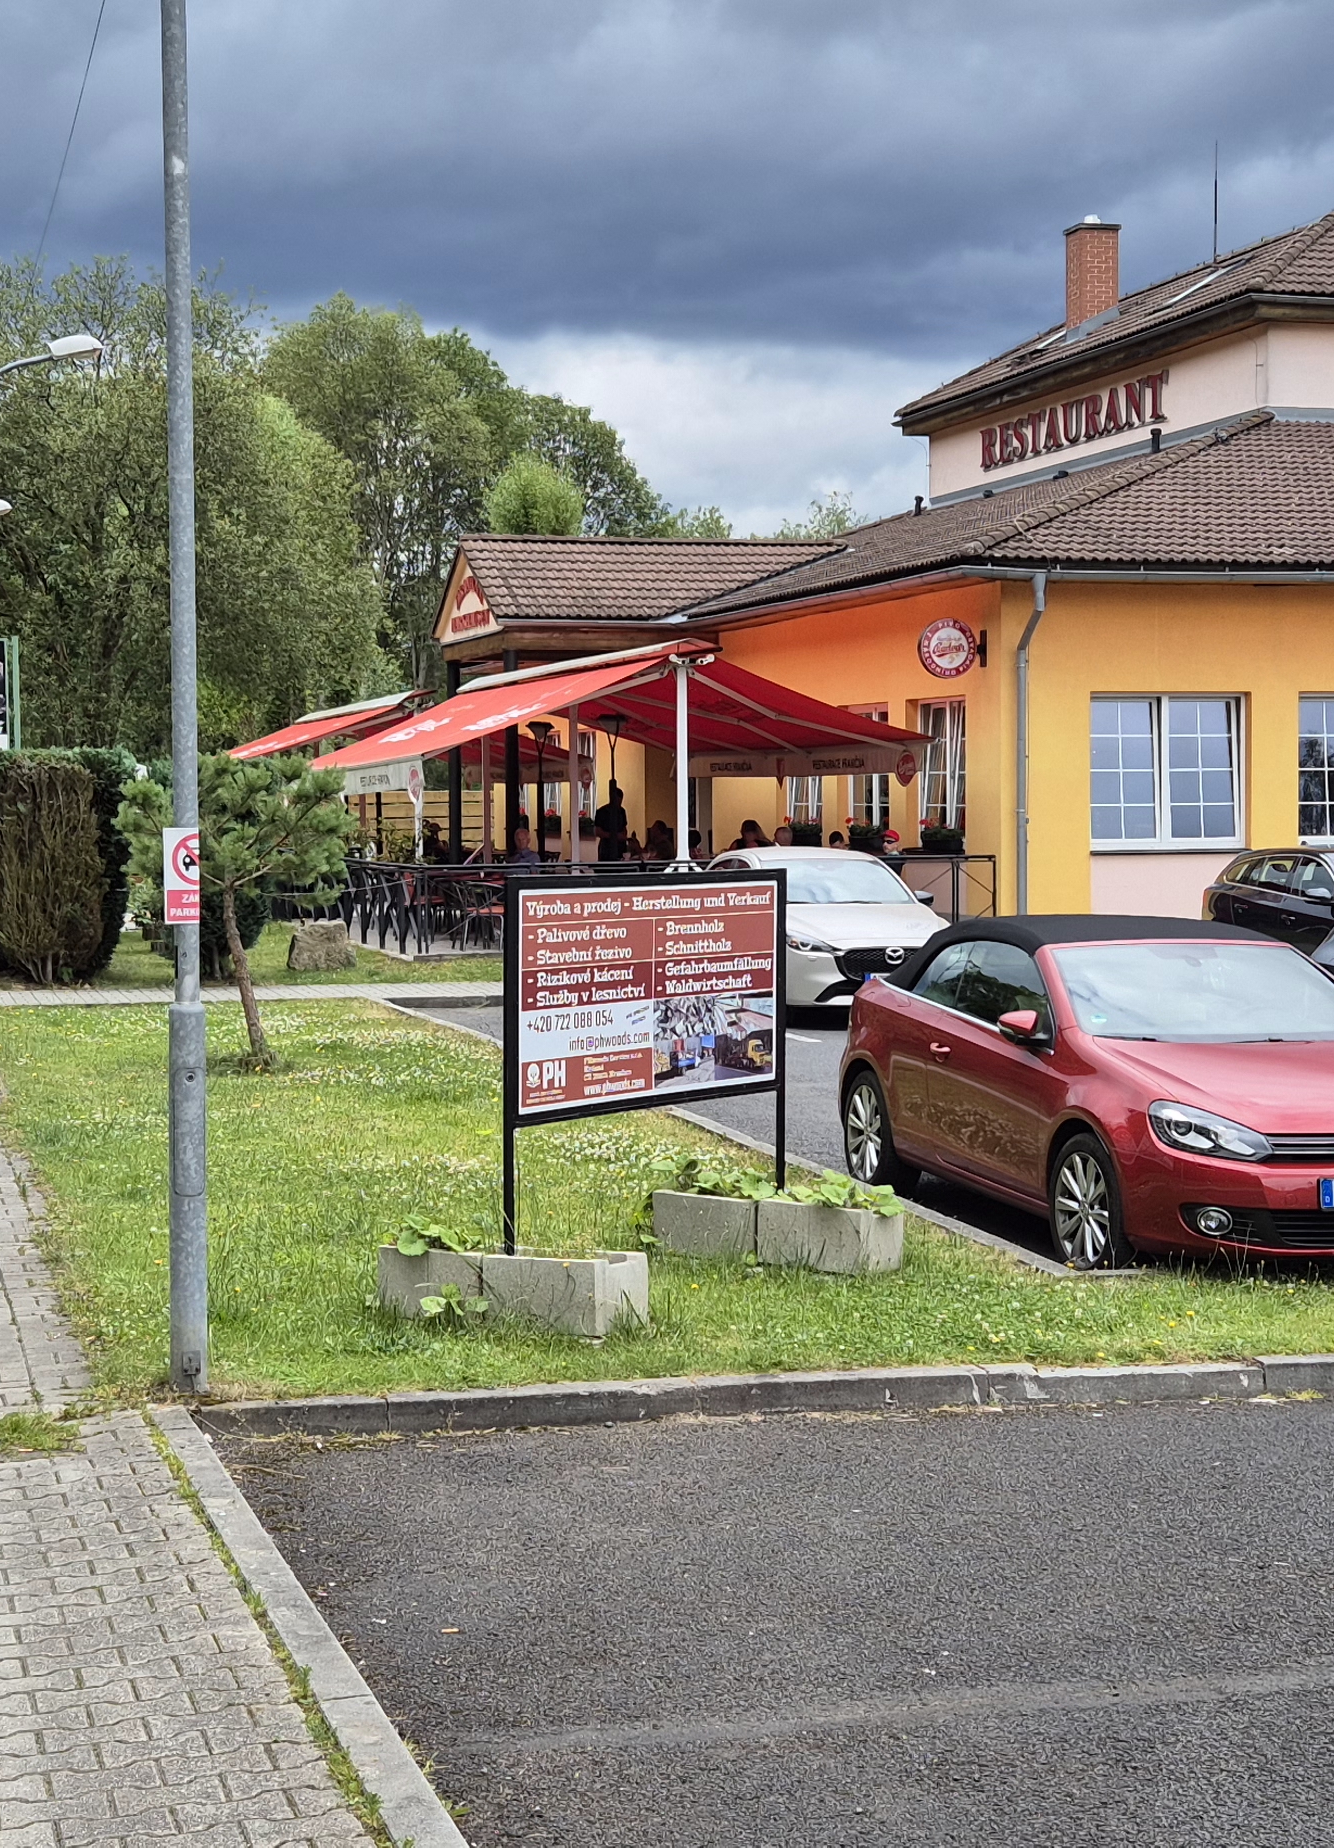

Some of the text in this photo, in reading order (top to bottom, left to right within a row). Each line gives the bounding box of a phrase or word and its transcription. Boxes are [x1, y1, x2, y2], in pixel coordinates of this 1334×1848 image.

[980, 370, 1169, 472] RESTAURANT
[526, 899, 571, 919] Výroba
[573, 902, 581, 914] a
[583, 898, 622, 917] prodej
[632, 894, 701, 912] Herstellung
[704, 893, 725, 908] und
[727, 891, 771, 906] Verkauf
[536, 926, 590, 944] Palivové
[592, 925, 627, 940] dřevo
[665, 919, 725, 936] Brennholz
[536, 946, 593, 965] Stavební
[594, 945, 632, 961] řezivo
[665, 938, 733, 956] Schnittholz
[536, 968, 591, 988] Rizikové
[593, 965, 635, 983] kácení
[664, 956, 772, 976] Gefahrbaumfällung
[664, 973, 753, 994] Waldwirtschaft
[536, 990, 579, 1008] Služby
[581, 991, 589, 1002] v
[591, 983, 646, 1001] lesnictví
[526, 1015, 552, 1033] +420
[554, 1013, 571, 1030] 722
[573, 1011, 593, 1029] 088
[595, 1009, 614, 1027] 054
[569, 1031, 650, 1051] info@phwoods.com
[542, 1060, 566, 1089] PH
